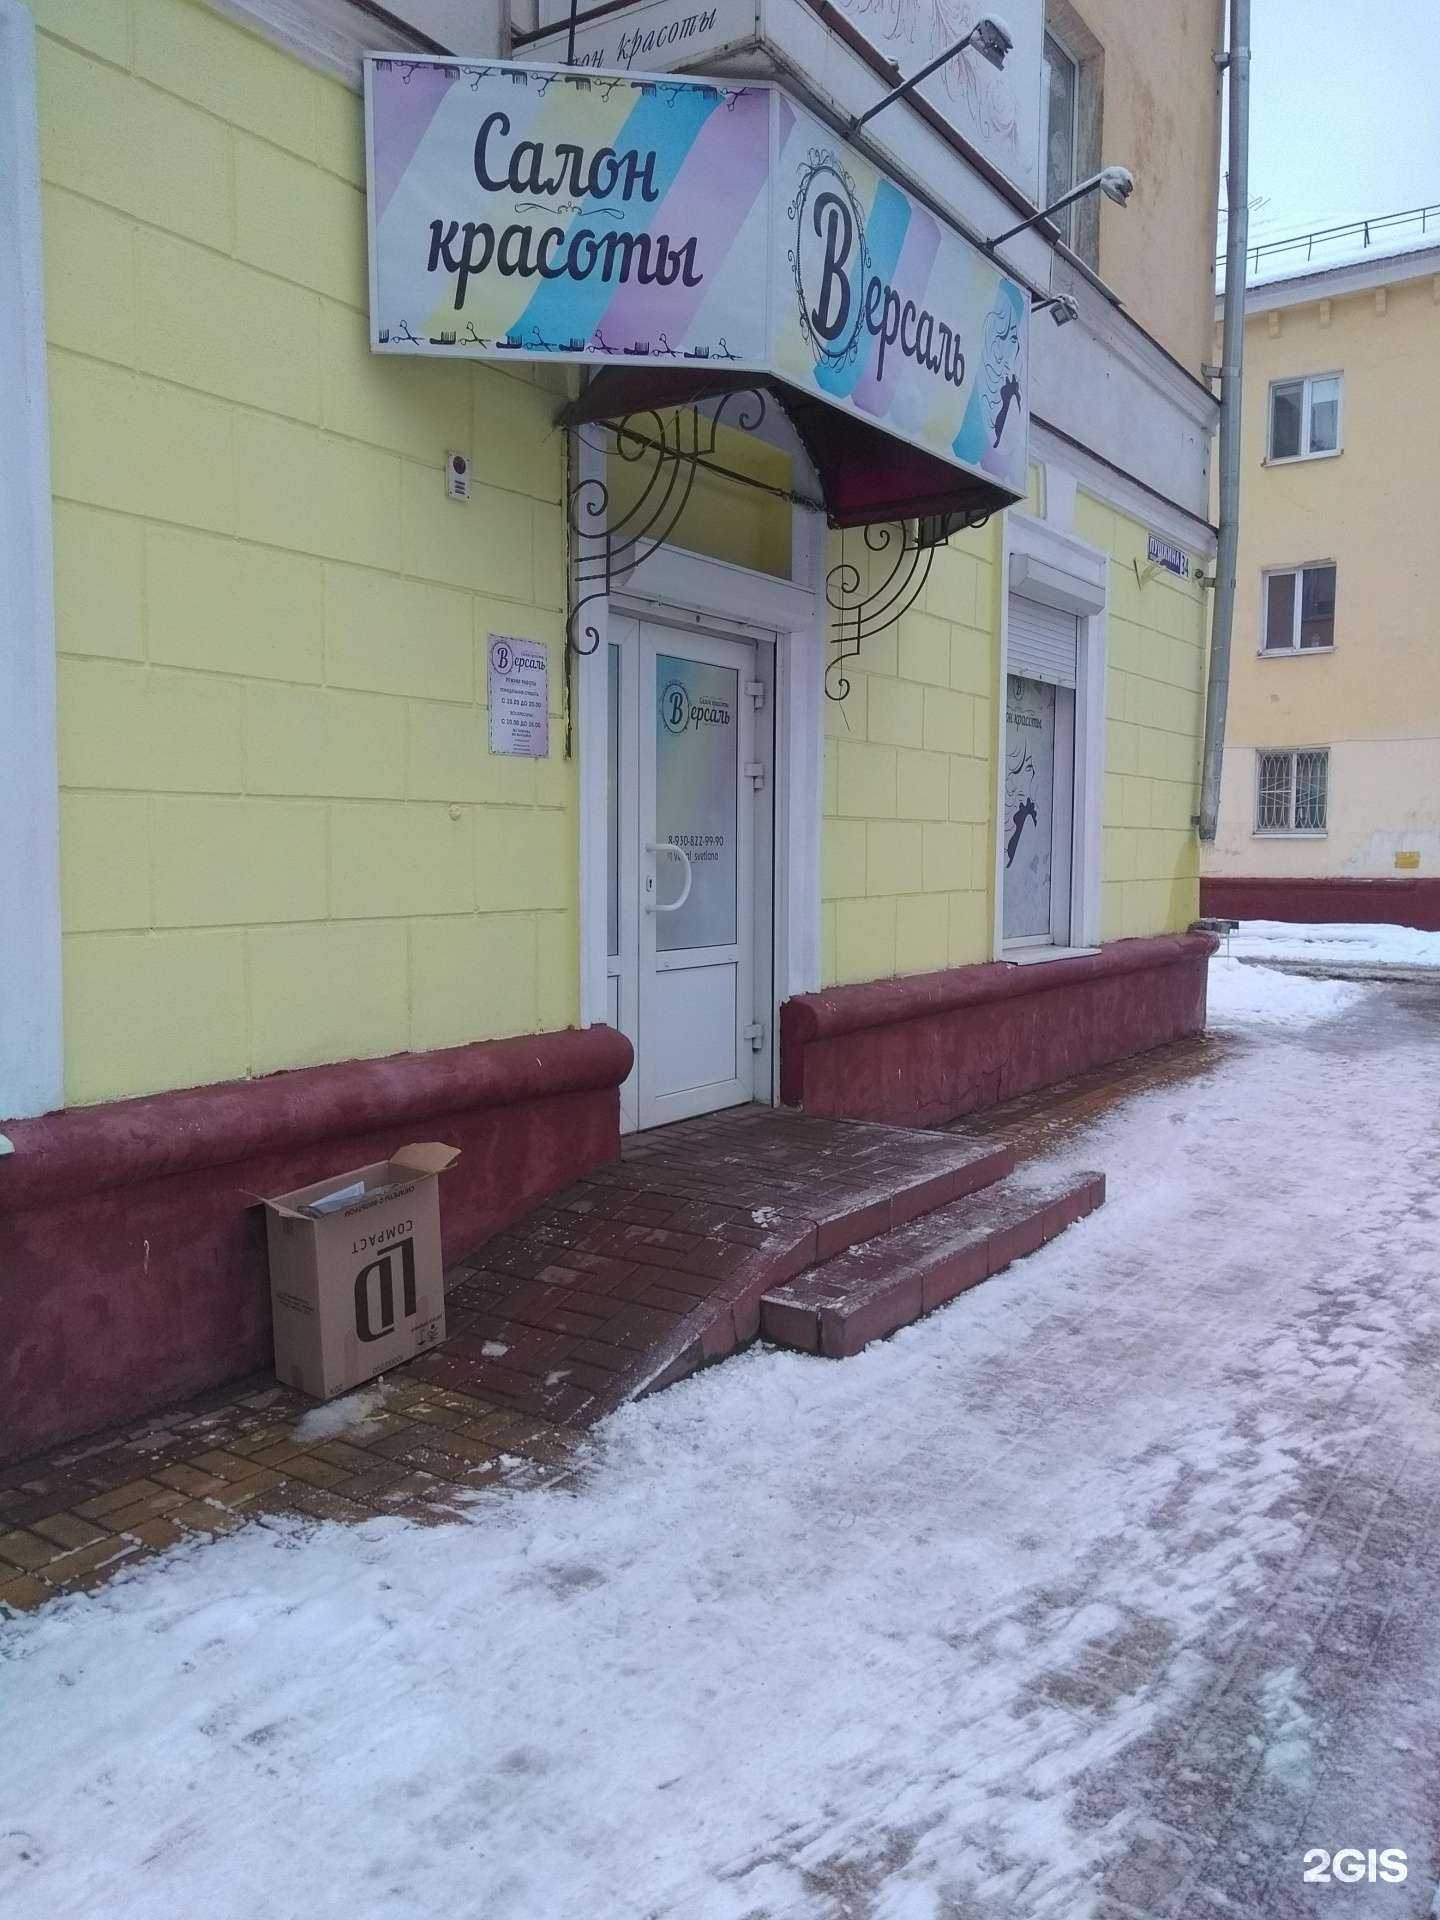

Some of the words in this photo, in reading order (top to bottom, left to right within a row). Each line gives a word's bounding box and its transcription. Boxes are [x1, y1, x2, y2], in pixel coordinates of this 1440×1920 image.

[617, 8, 717, 70] красоты
[474, 111, 659, 202] Салон
[427, 219, 703, 310] красоты
[811, 191, 965, 387] Версаль
[1149, 537, 1180, 567] ПУШКИНА
[498, 647, 546, 673] Версаль
[669, 692, 731, 730] Версаль
[352, 1219, 414, 1255] COMPACT
[354, 1236, 417, 1343] LD
